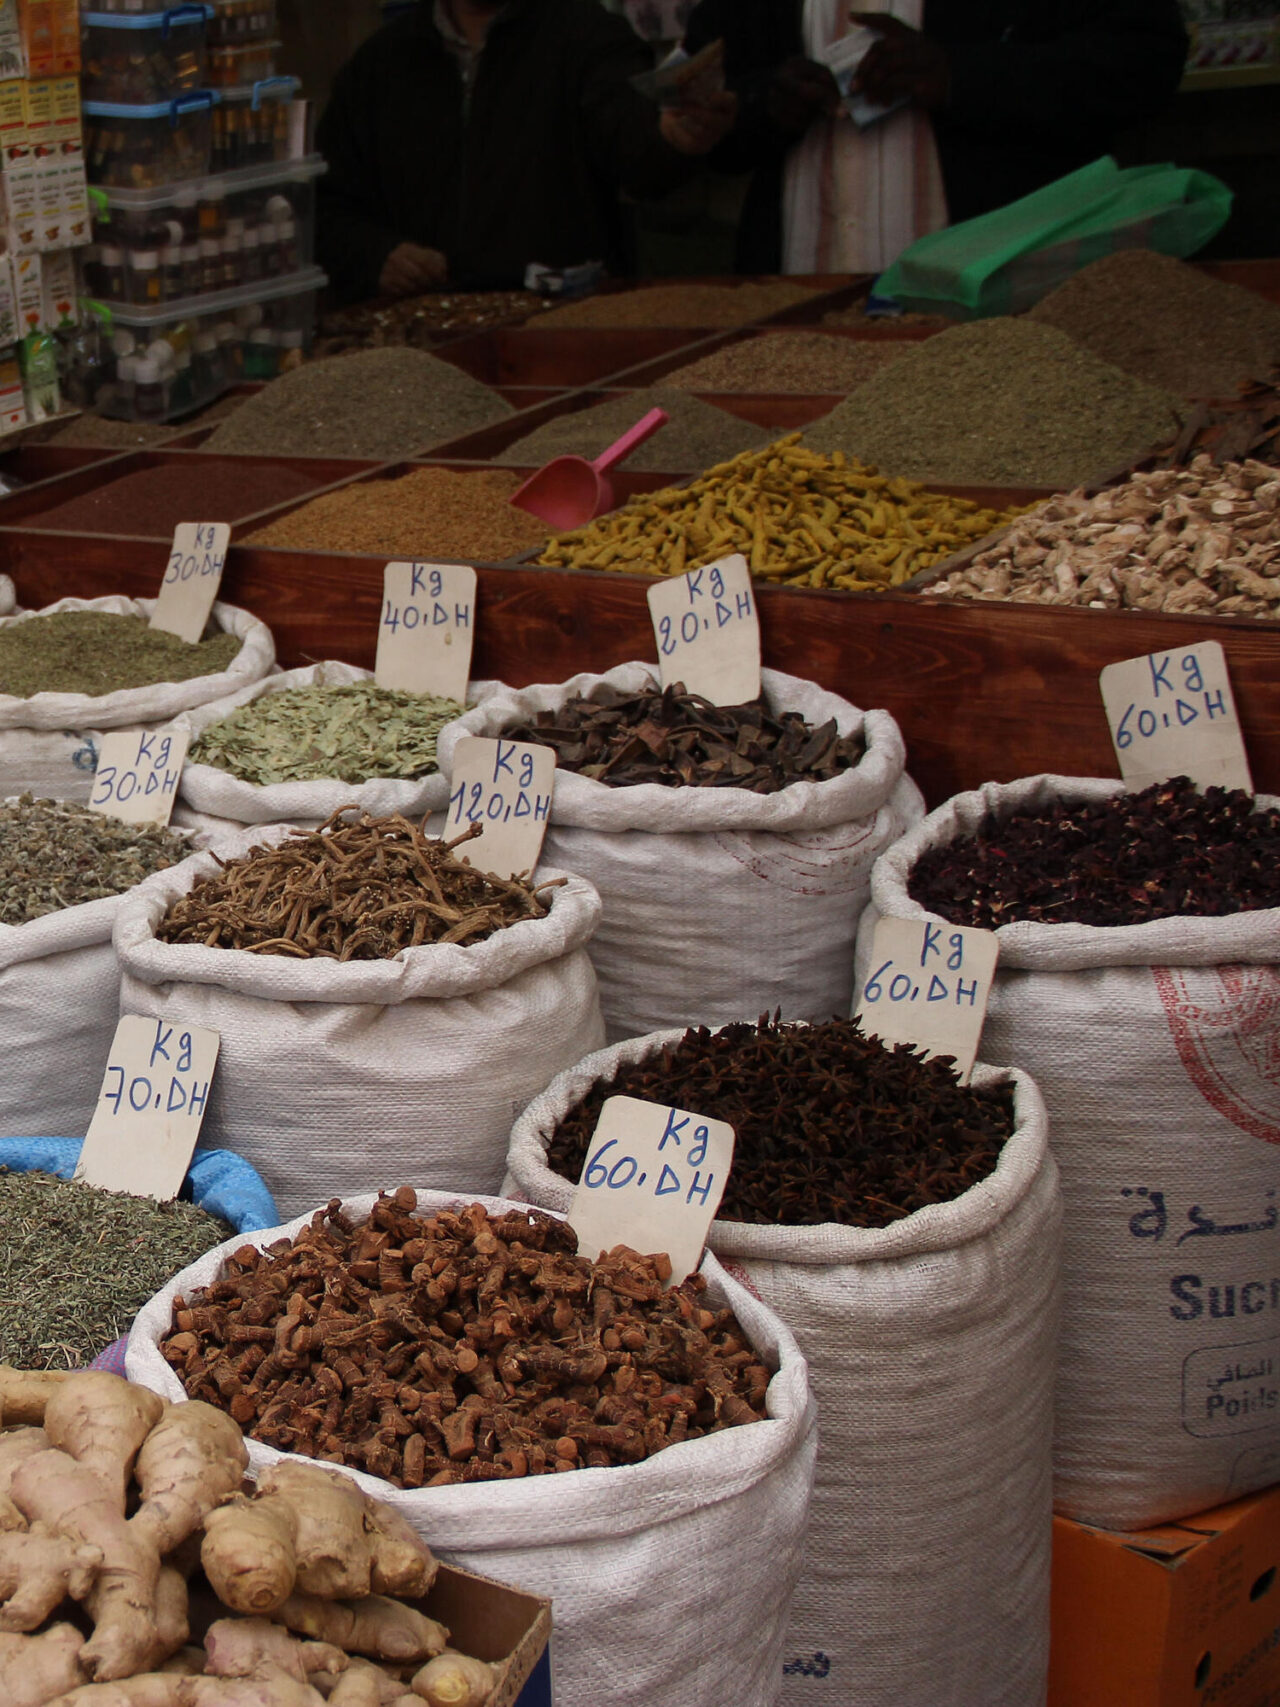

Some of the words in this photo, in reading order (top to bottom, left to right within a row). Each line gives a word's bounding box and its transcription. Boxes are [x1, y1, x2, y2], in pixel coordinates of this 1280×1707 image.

[194, 524, 215, 550] Kg
[411, 562, 442, 598] Kg
[686, 567, 725, 605] Kg
[1148, 653, 1204, 698] Kg
[135, 731, 172, 770] Kg
[493, 740, 534, 788] Kg
[921, 921, 963, 971] Kg
[150, 1020, 192, 1073] Kg
[658, 1108, 709, 1168] Kg
